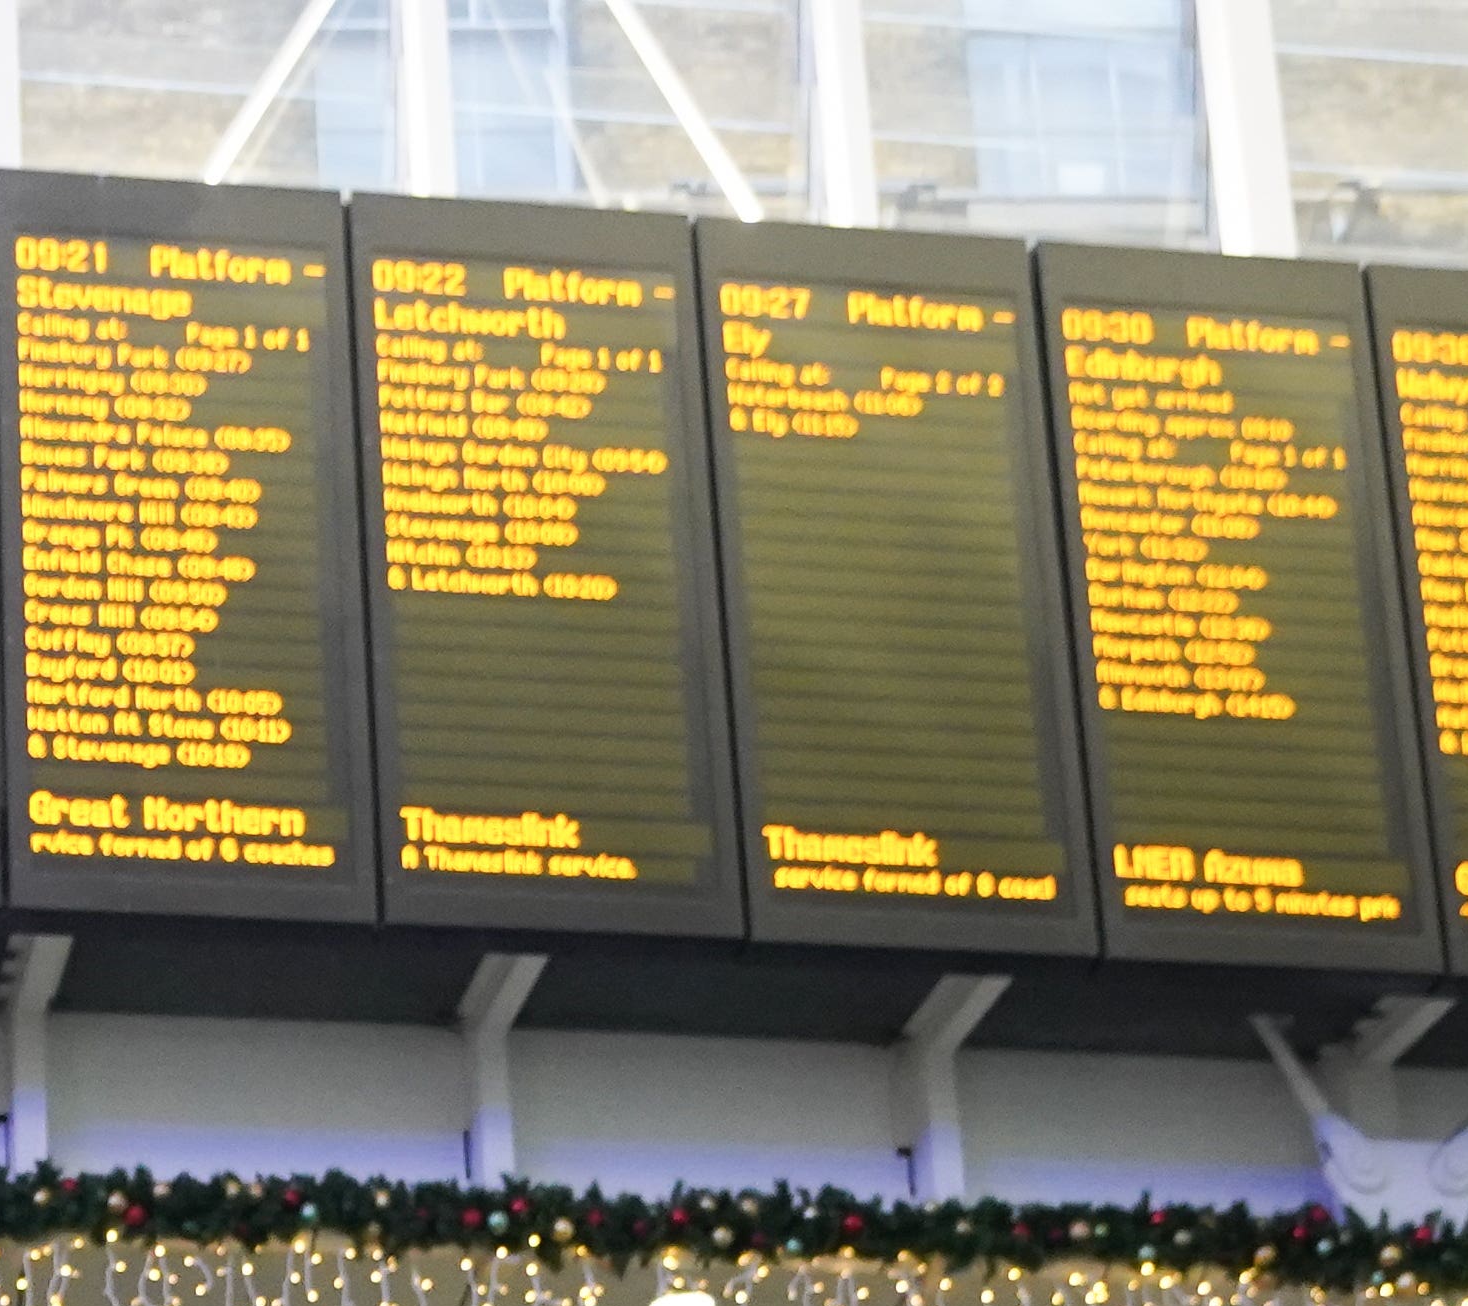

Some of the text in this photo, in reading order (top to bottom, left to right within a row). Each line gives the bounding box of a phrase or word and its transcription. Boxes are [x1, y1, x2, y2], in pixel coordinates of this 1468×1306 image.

[16, 237, 292, 284] 09:21 Platform
[17, 275, 193, 319] Stevenage
[372, 260, 643, 306] 09:22 Platform
[373, 298, 567, 340] Letchworth
[719, 284, 985, 331] 09:27 Platform
[722, 320, 772, 357] Ely
[1062, 309, 1320, 355] 09:30 Platform
[1065, 345, 1223, 387] Edinburgh
[28, 790, 307, 837] Great Northern
[400, 805, 581, 848] Thameslink
[762, 824, 939, 867] Thameslink
[1203, 849, 1305, 887] Azuma
